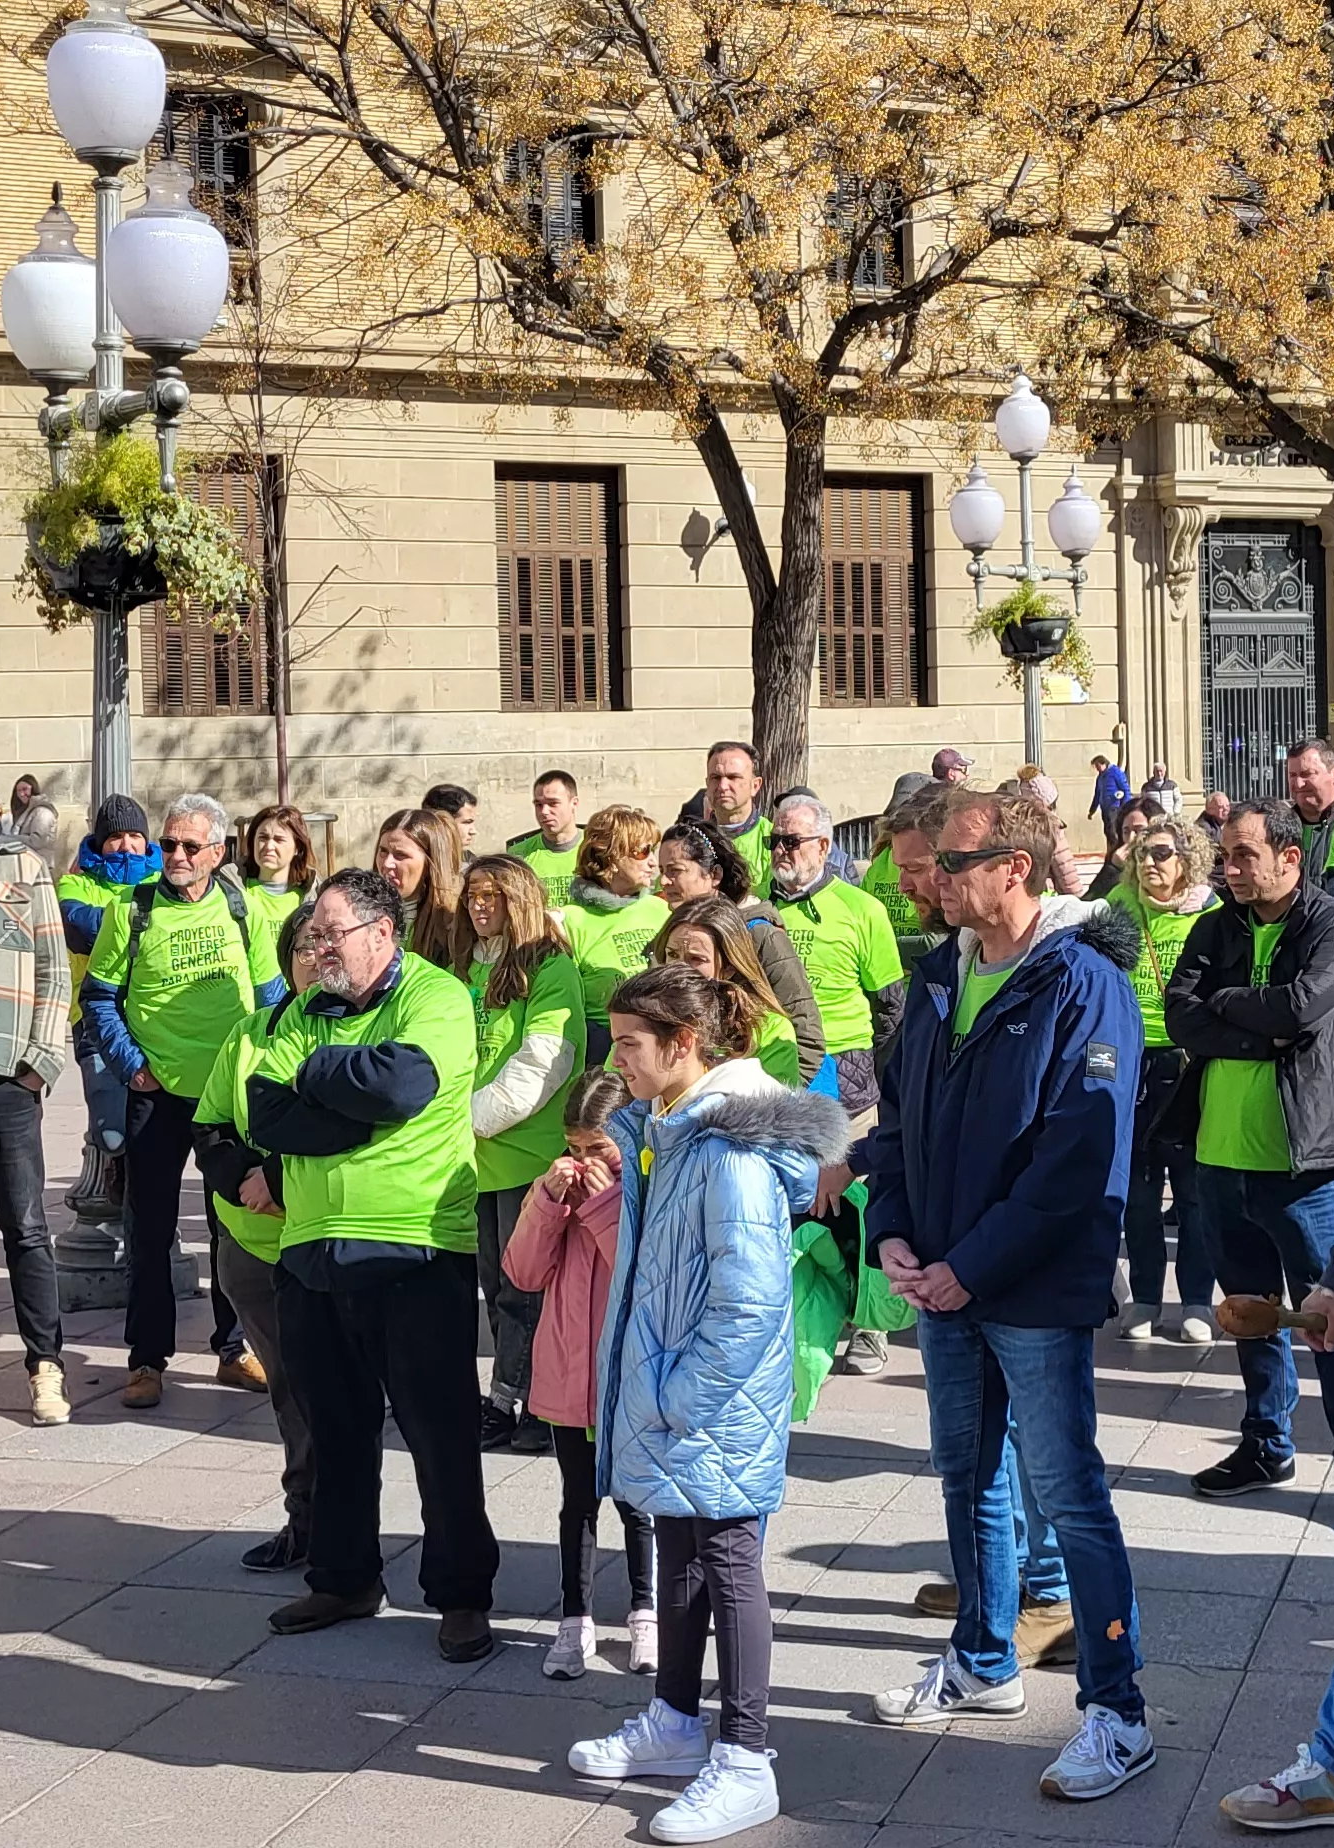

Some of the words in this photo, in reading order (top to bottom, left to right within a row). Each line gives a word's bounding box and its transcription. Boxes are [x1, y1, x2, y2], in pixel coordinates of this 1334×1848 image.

[1209, 451, 1312, 467] HACIEND
[170, 925, 225, 943] PROYECTO
[181, 938, 227, 955] INTERES
[172, 949, 228, 971] GENERAL
[193, 967, 226, 981] QUIEN
